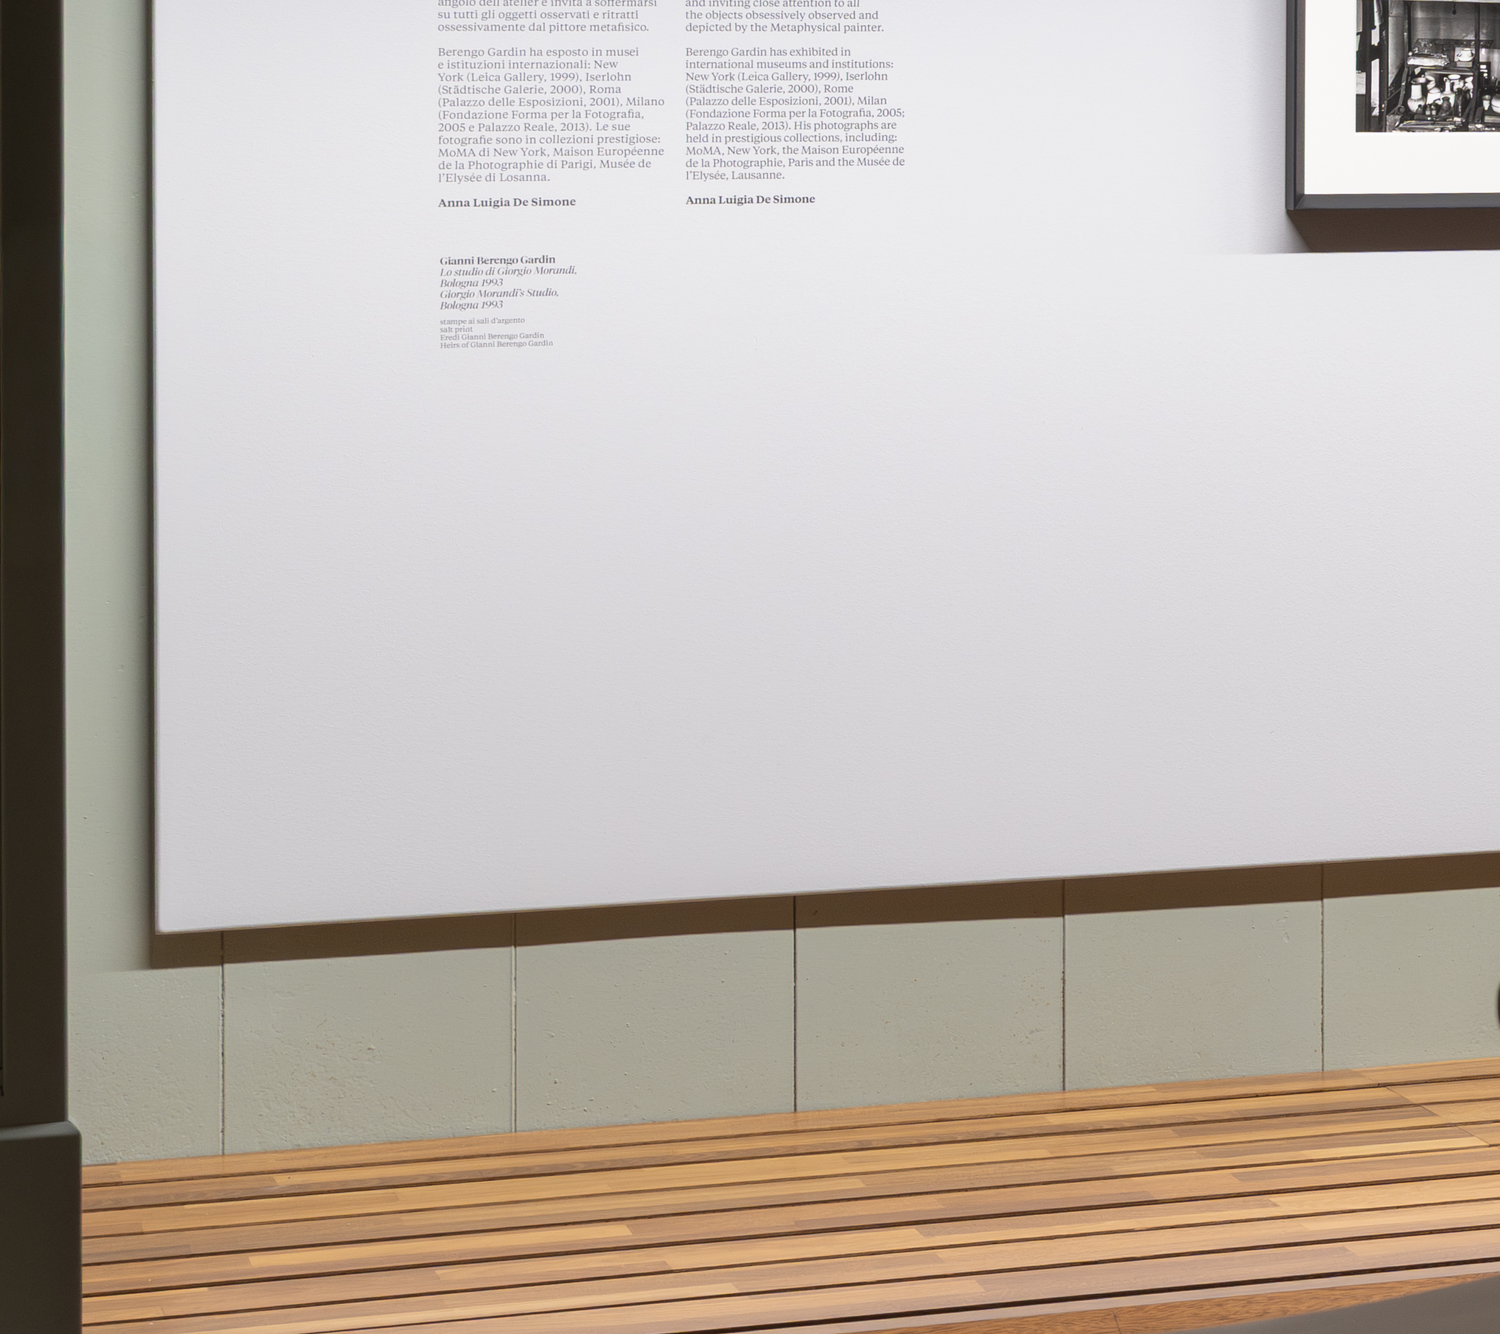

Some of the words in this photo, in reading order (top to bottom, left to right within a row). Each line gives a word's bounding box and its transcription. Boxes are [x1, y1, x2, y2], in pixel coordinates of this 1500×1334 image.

[438, 47, 485, 58] Berengo
[487, 47, 527, 56] Gardin
[529, 47, 544, 56] ha
[546, 47, 589, 58] esposto
[591, 47, 603, 56] in
[606, 47, 639, 56] musei
[685, 47, 729, 58] Berengo
[730, 47, 768, 56] Gardin
[769, 47, 788, 56] has
[789, 47, 838, 56] exhibited
[840, 47, 851, 56] in
[438, 85, 502, 96] (Städtische
[504, 85, 547, 95] Galerie,
[550, 85, 586, 95] 2000),
[589, 84, 622, 94] Roma
[438, 97, 486, 108] (Palazzo
[488, 97, 516, 106] delle
[518, 97, 587, 108] Esposizioni,
[589, 97, 623, 108] 2001),
[626, 97, 665, 106] Milano
[685, 108, 751, 119] (Fondazione
[753, 108, 787, 118] Forma
[788, 111, 807, 119] per
[808, 108, 818, 117] la
[820, 108, 875, 119] Fotografia,
[876, 108, 905, 118] 2005;
[686, 146, 725, 156] MoMA,
[727, 145, 751, 155] New
[752, 145, 780, 156] York,
[782, 145, 800, 154] the
[800, 145, 840, 154] Maison
[842, 144, 905, 156] Européenne
[438, 198, 471, 207] Anna
[473, 197, 511, 209] Luigia
[513, 197, 529, 207] De
[531, 197, 576, 206] Simone
[686, 195, 716, 204] Anna
[718, 194, 754, 206] Luigia
[756, 194, 772, 204] De
[773, 194, 816, 203] Simone
[440, 255, 475, 265] Gianni
[477, 255, 519, 266] Berengo
[520, 254, 556, 264] Gardin
[440, 267, 453, 276] Lo
[453, 266, 484, 276] studio
[485, 266, 496, 275] di
[497, 266, 532, 277] Giorgio
[440, 277, 479, 289] Bologna
[481, 277, 504, 286] 1993
[440, 288, 476, 300] Giorgio
[440, 300, 480, 311] Bologna
[481, 299, 504, 309] 1993
[439, 317, 468, 326] stampe
[488, 332, 519, 341] Berengo
[519, 331, 545, 339] Gardin
[497, 341, 528, 349] Berengo
